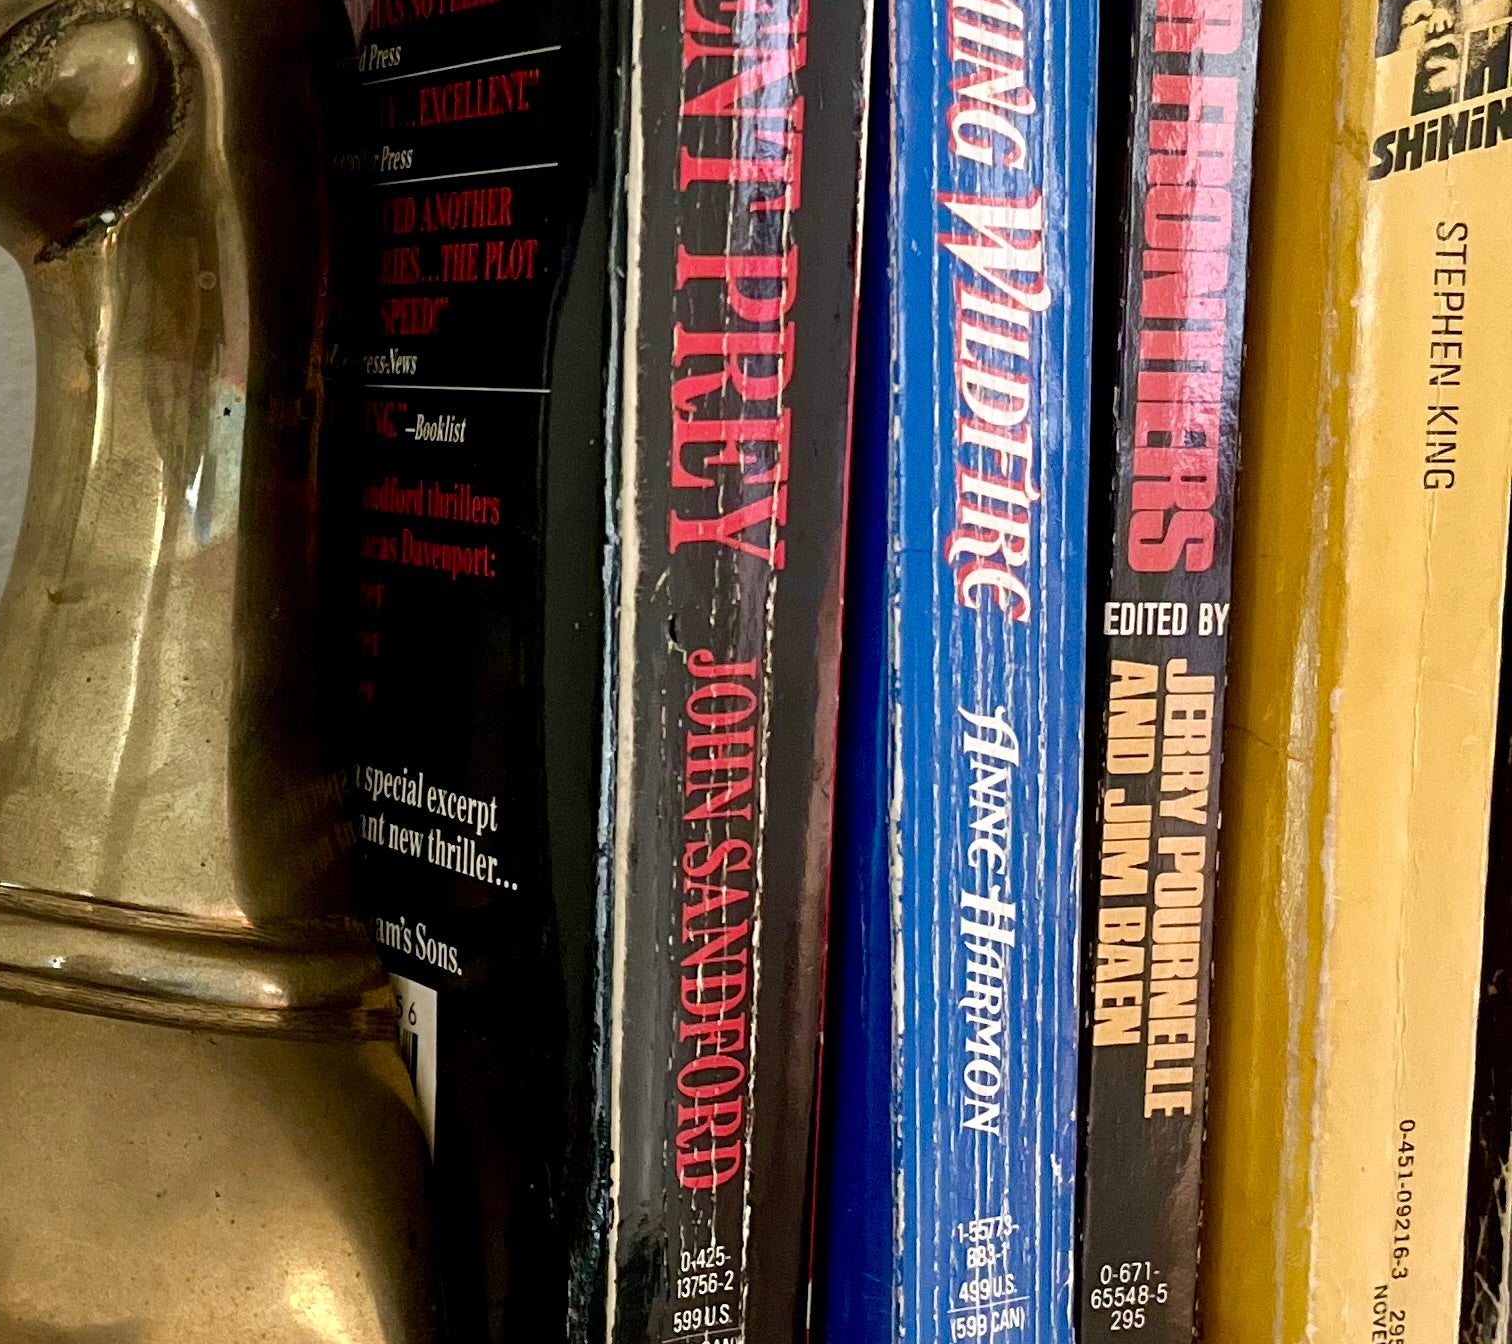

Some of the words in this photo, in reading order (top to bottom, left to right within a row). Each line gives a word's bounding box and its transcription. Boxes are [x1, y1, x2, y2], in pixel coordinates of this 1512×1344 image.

[369, 44, 402, 72] Press
[380, 145, 414, 173] Press
[1368, 96, 1512, 181] SHiNiN
[421, 187, 513, 234] ANOTHER
[482, 237, 540, 282] PLOT
[1127, 75, 1239, 574] FRONTIERS
[1428, 221, 1468, 387] STEPHEN
[668, 243, 799, 570] PREY
[936, 186, 1052, 624] WILDFIRE
[1423, 405, 1460, 490] KING
[427, 480, 501, 527] thrillers
[401, 527, 496, 582] Davenport:
[1103, 601, 1188, 637] EDITED
[1198, 602, 1231, 637] BY
[681, 646, 758, 823] JOHN
[1106, 659, 1160, 776] AND
[1158, 657, 1216, 826] JERRY
[364, 764, 424, 809] special
[426, 786, 499, 837] excerpt
[957, 705, 1019, 876] ANNE
[359, 811, 390, 846] ant
[388, 822, 425, 859] new
[1100, 787, 1152, 898] JIM
[375, 915, 418, 955] am's
[420, 921, 468, 977] Sons.
[1091, 906, 1147, 1047] BAEN
[1143, 835, 1207, 1119] POURNELLE
[675, 838, 752, 1191] SANDFORD
[958, 883, 1017, 1137] HARMON
[1390, 1118, 1416, 1281] 0-451-09216-3
[676, 1269, 735, 1299] 13756-2
[958, 1278, 989, 1304] 499
[1090, 1283, 1168, 1310] 65548-5
[1099, 1261, 1160, 1285] 0-671-
[673, 1307, 702, 1334] 599
[1110, 1308, 1146, 1331] 295
